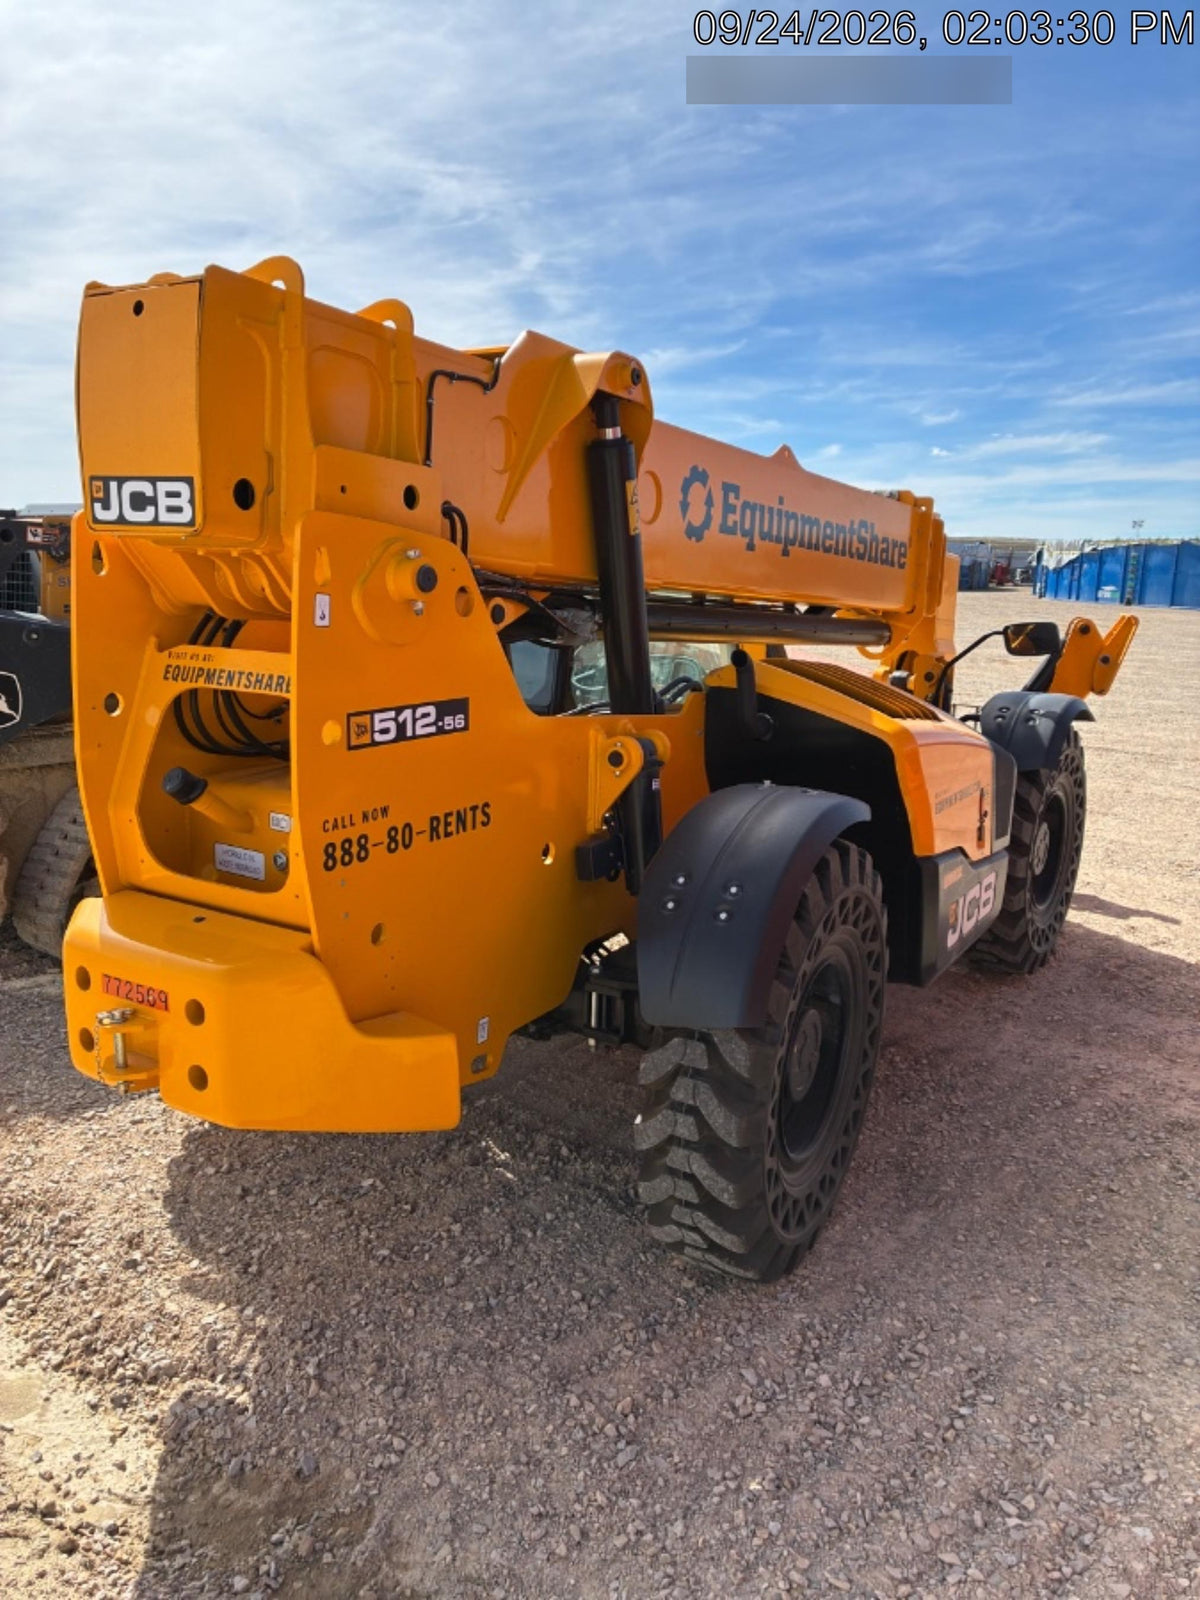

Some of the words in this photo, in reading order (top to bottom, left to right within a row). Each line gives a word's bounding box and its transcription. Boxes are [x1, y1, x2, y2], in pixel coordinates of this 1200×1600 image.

[93, 480, 193, 523] JCB
[718, 481, 908, 570] EquipmentShare
[322, 813, 356, 833] CALL
[362, 804, 390, 824] NOW
[322, 801, 492, 872] 888-80-RENTS
[947, 871, 997, 948] JCB
[102, 973, 169, 1011] 772569
